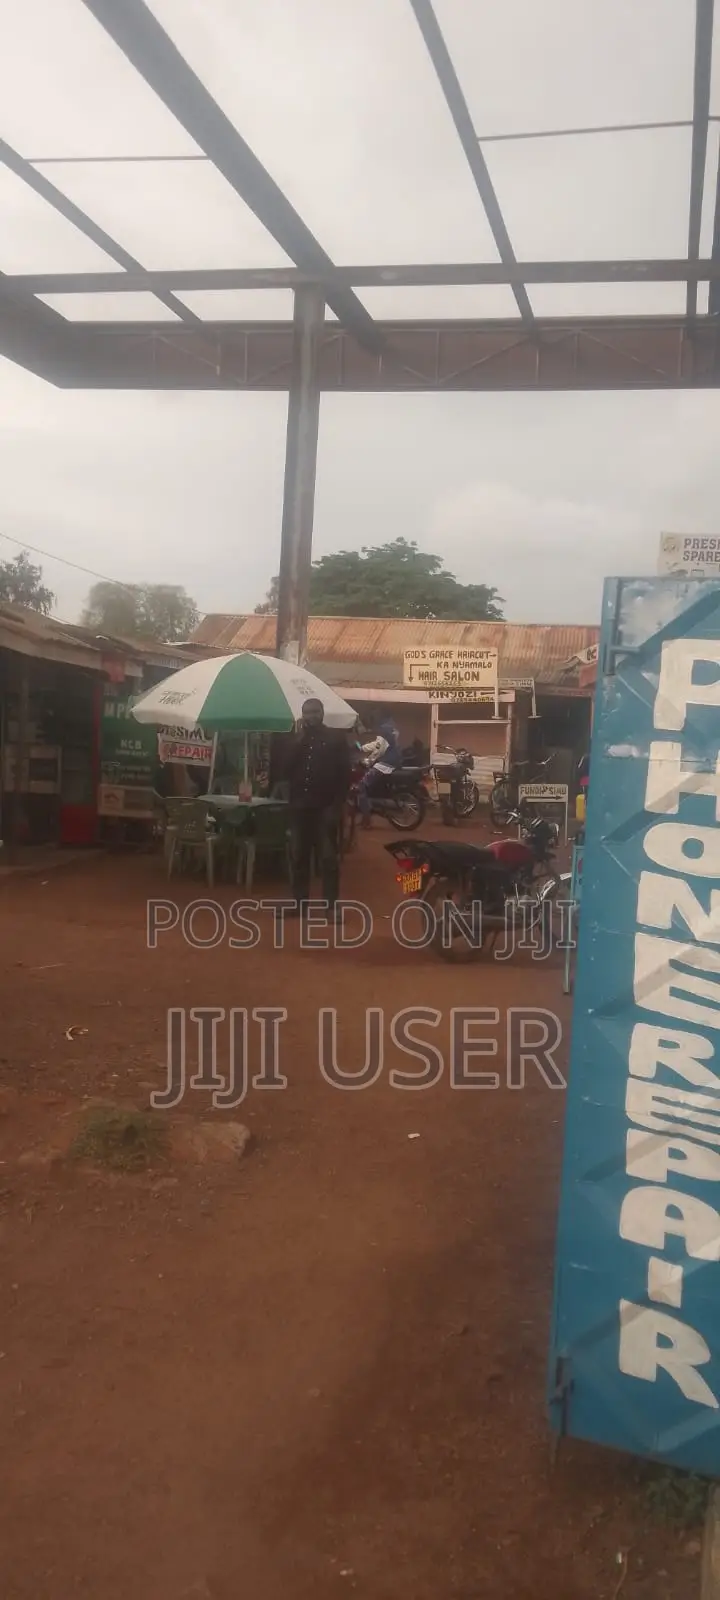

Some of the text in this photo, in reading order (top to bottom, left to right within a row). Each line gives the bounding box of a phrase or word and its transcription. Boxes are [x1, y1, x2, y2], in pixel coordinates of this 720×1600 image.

[404, 650, 427, 659] GOD'S
[429, 650, 454, 659] GRACE
[436, 661, 493, 669] KA NYAMALO
[418, 671, 480, 681] HAIR SALON
[120, 739, 142, 750] KCB
